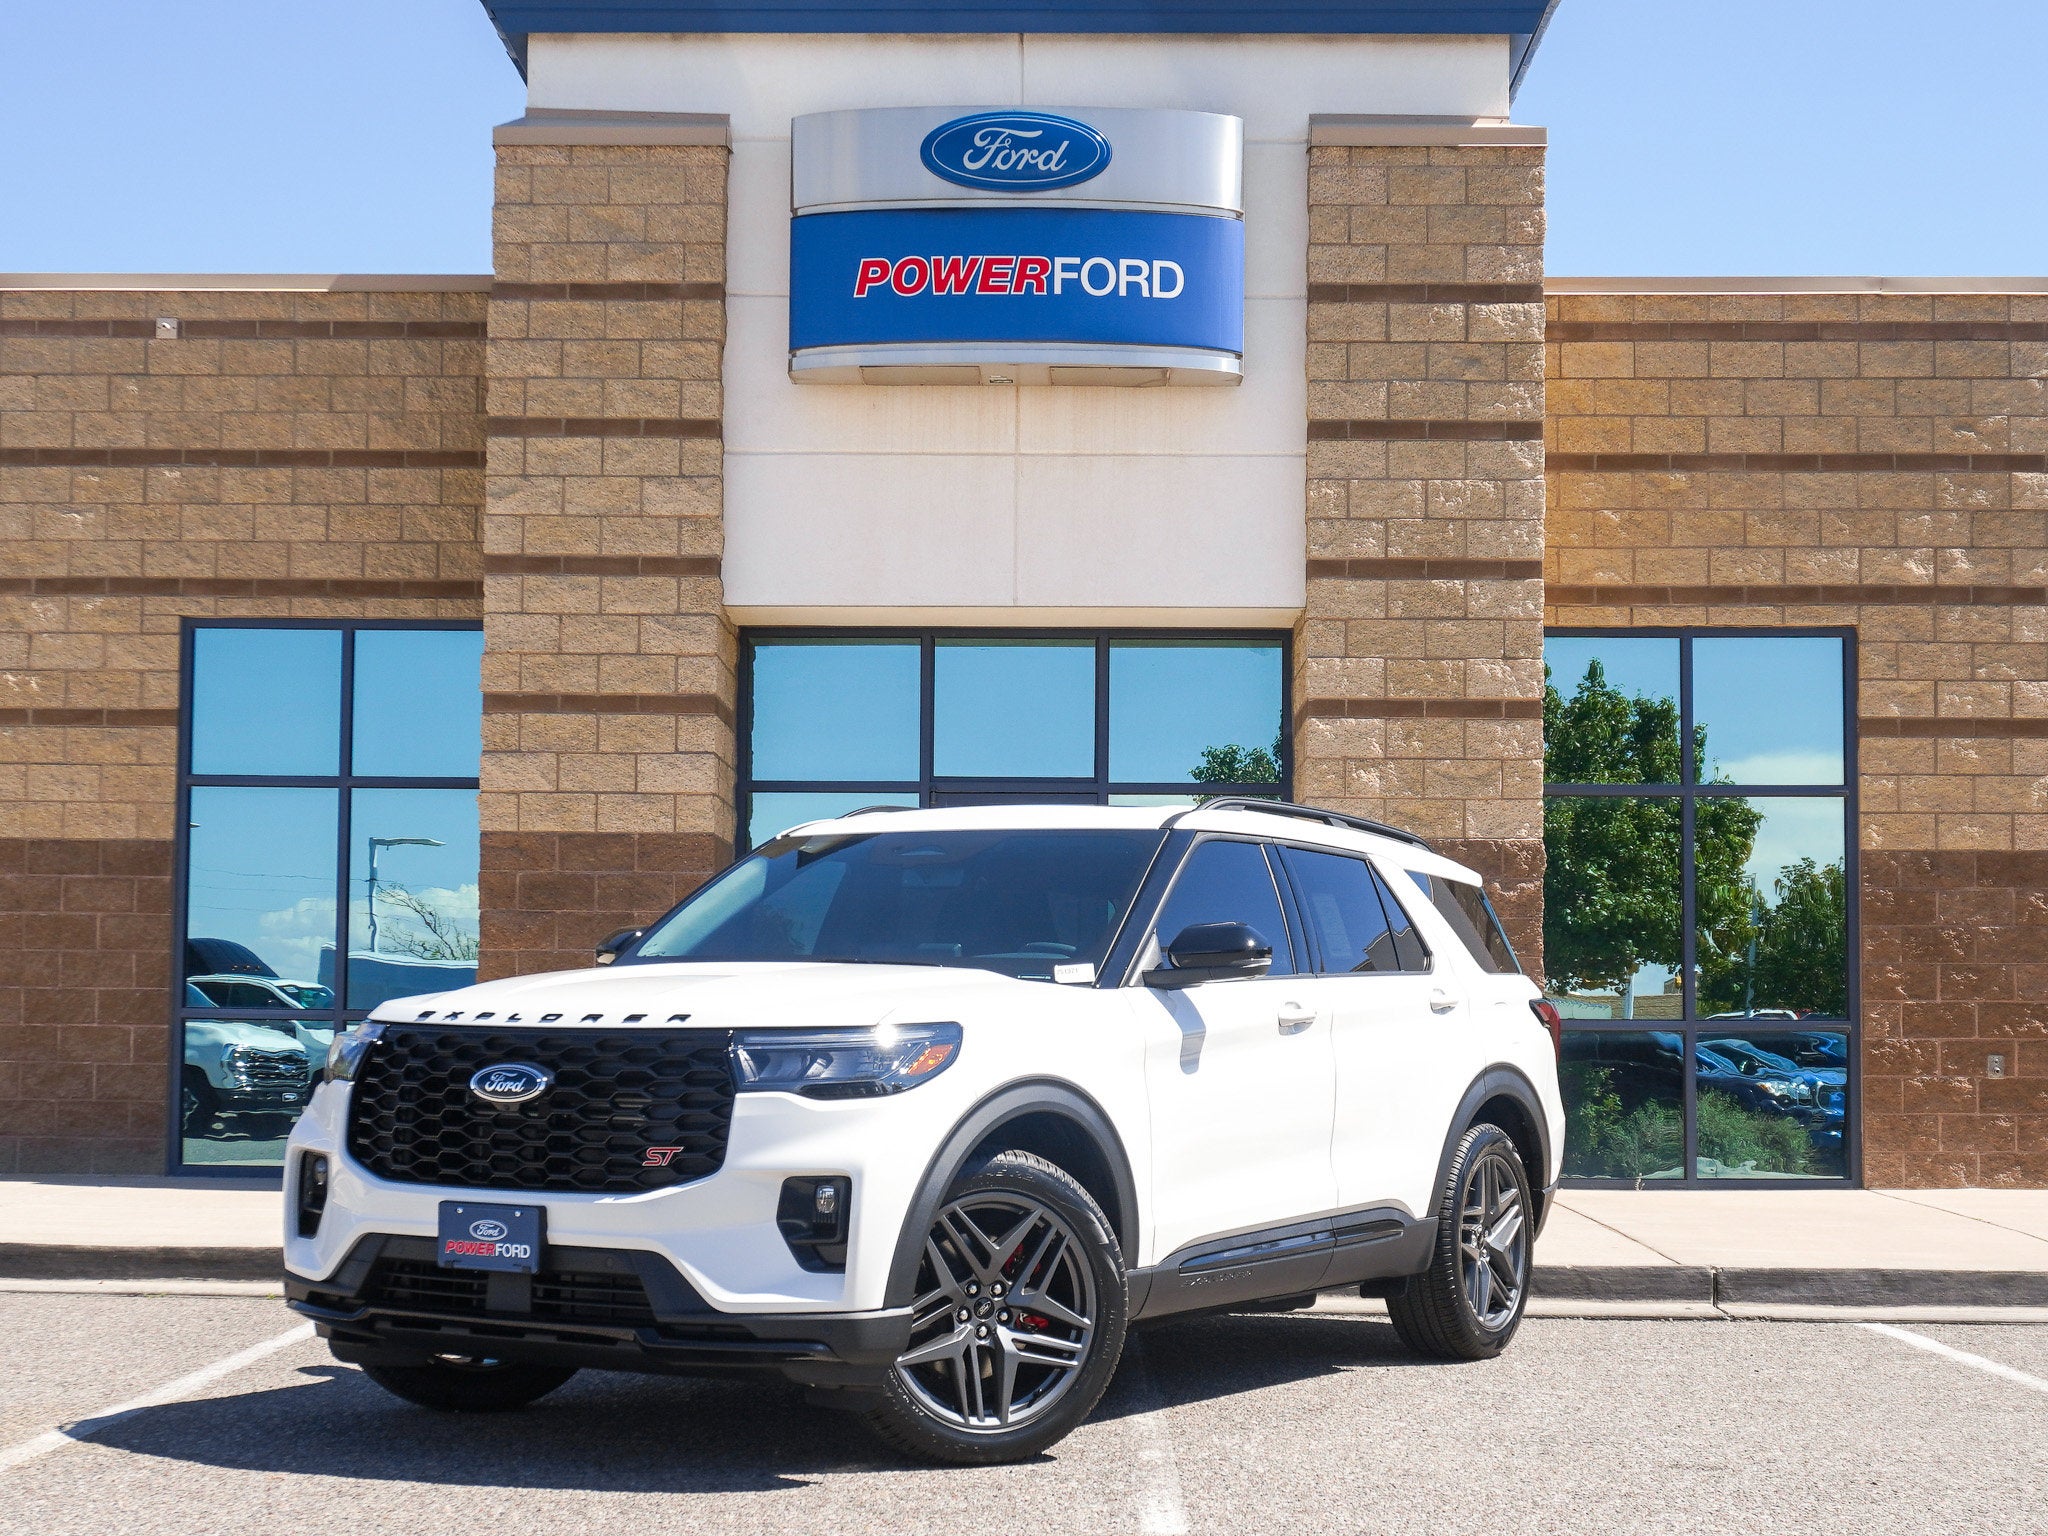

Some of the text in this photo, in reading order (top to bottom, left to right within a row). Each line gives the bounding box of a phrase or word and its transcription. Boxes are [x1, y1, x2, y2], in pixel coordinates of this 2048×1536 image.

[962, 127, 1069, 172] Ford
[853, 255, 1185, 299] POWERFORD
[415, 1010, 692, 1023] EXPLORER
[484, 1071, 527, 1092] Ford
[642, 1146, 684, 1167] ST
[476, 1223, 501, 1237] Ford
[445, 1240, 531, 1259] POWERFORD
